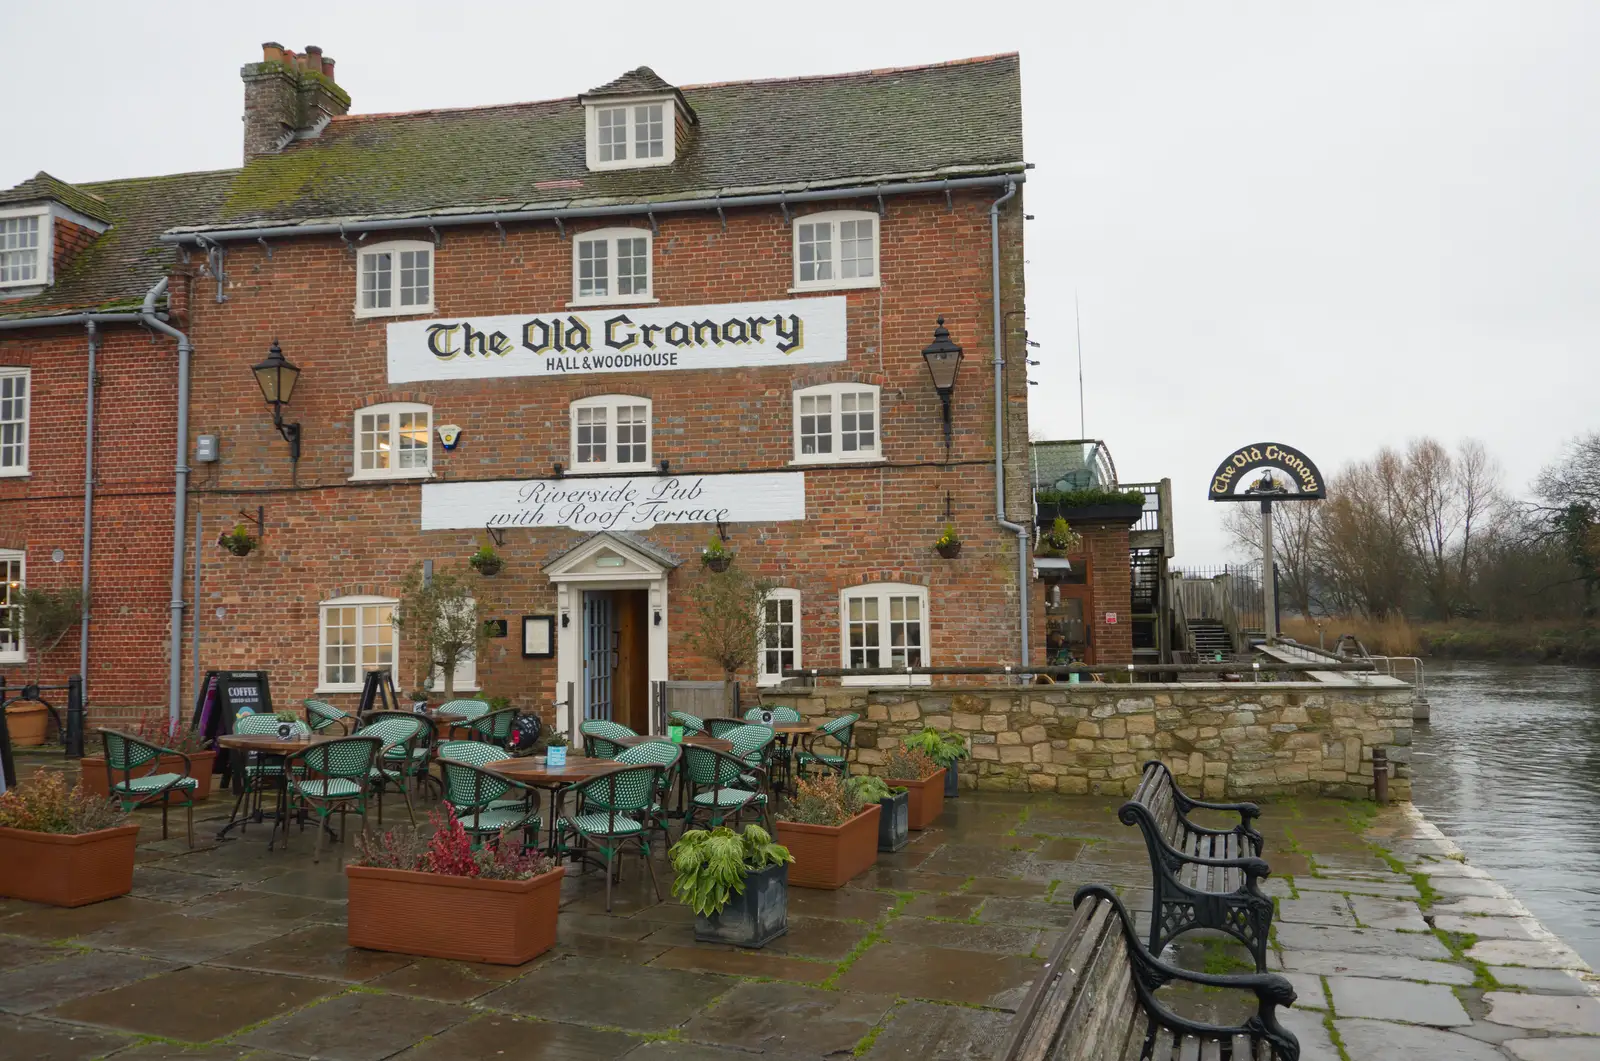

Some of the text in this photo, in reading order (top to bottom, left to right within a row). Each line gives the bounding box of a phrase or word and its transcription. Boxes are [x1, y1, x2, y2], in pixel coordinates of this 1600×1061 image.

[425, 313, 804, 361] The Old Granary
[1211, 445, 1319, 493] The Old Granary
[517, 478, 706, 504] Riverside Pub
[487, 501, 730, 529] with Roof Terrace
[228, 686, 259, 697] COFFEE
